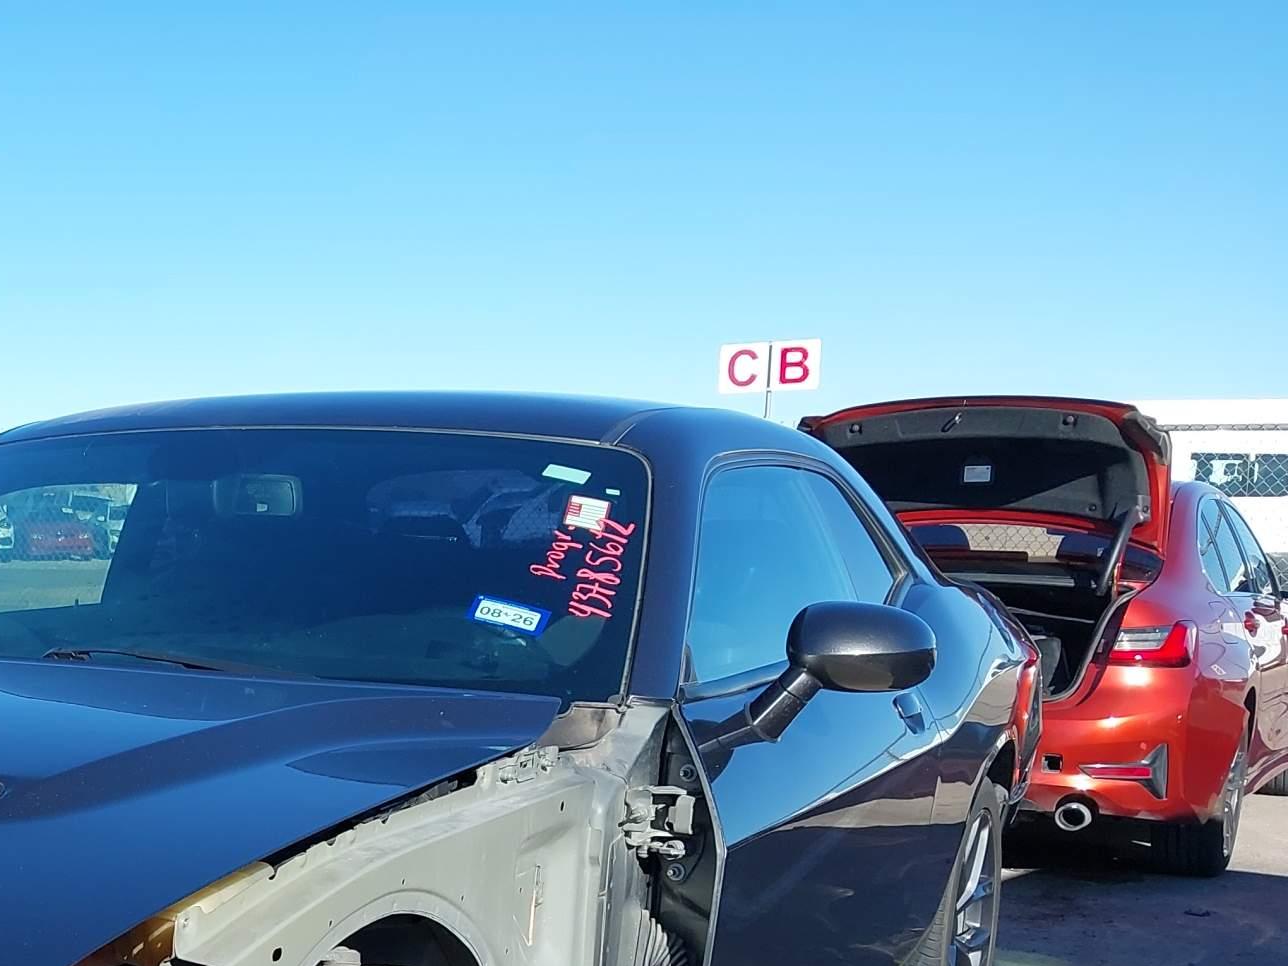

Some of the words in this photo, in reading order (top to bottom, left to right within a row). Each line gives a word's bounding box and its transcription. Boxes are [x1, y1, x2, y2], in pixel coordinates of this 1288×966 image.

[727, 349, 759, 387] C
[778, 346, 810, 385] B
[568, 517, 636, 618] 43785612
